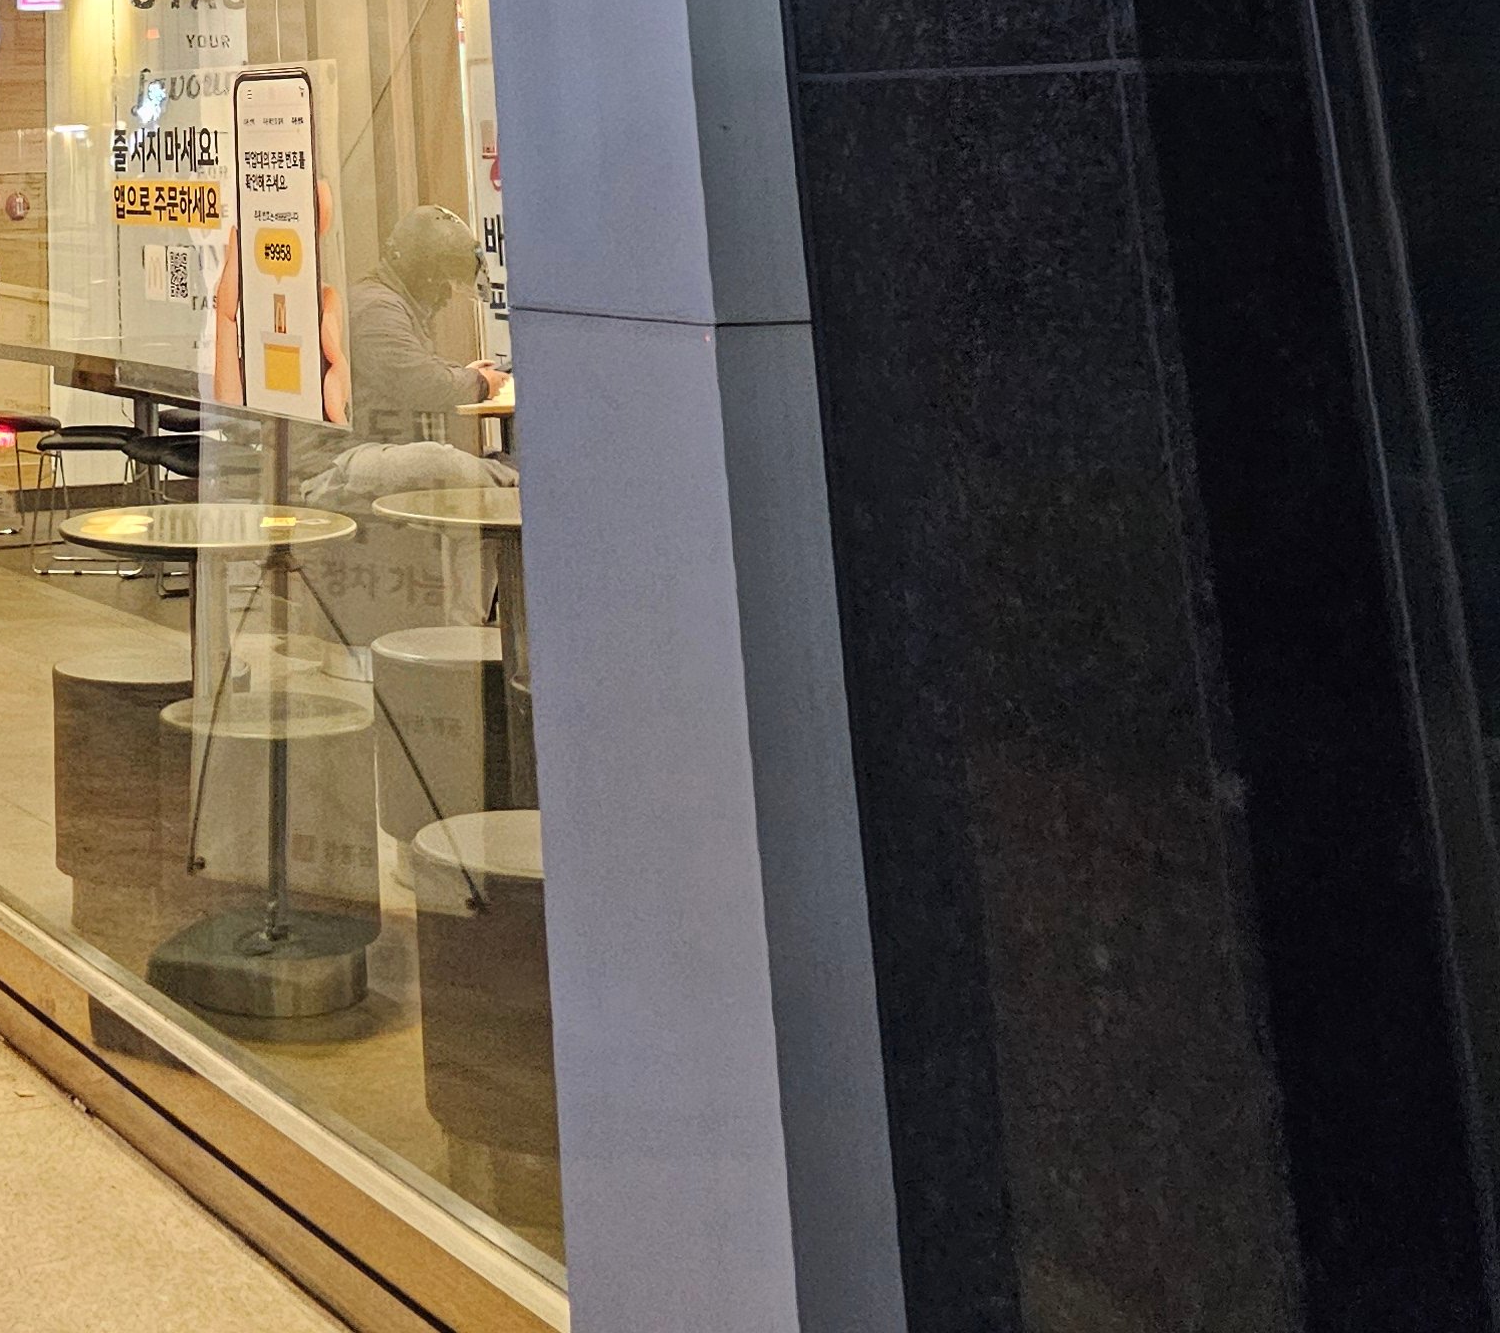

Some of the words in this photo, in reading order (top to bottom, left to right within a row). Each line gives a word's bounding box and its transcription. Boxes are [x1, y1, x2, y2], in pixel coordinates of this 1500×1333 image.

[186, 34, 231, 49] YOUR
[112, 128, 129, 172] 줄
[130, 127, 162, 173] 서지
[164, 126, 220, 173] 마세요!
[270, 151, 284, 169] 주문
[113, 184, 152, 220] 앱으로
[153, 185, 220, 224] 주문하세요
[264, 243, 291, 262] #9958
